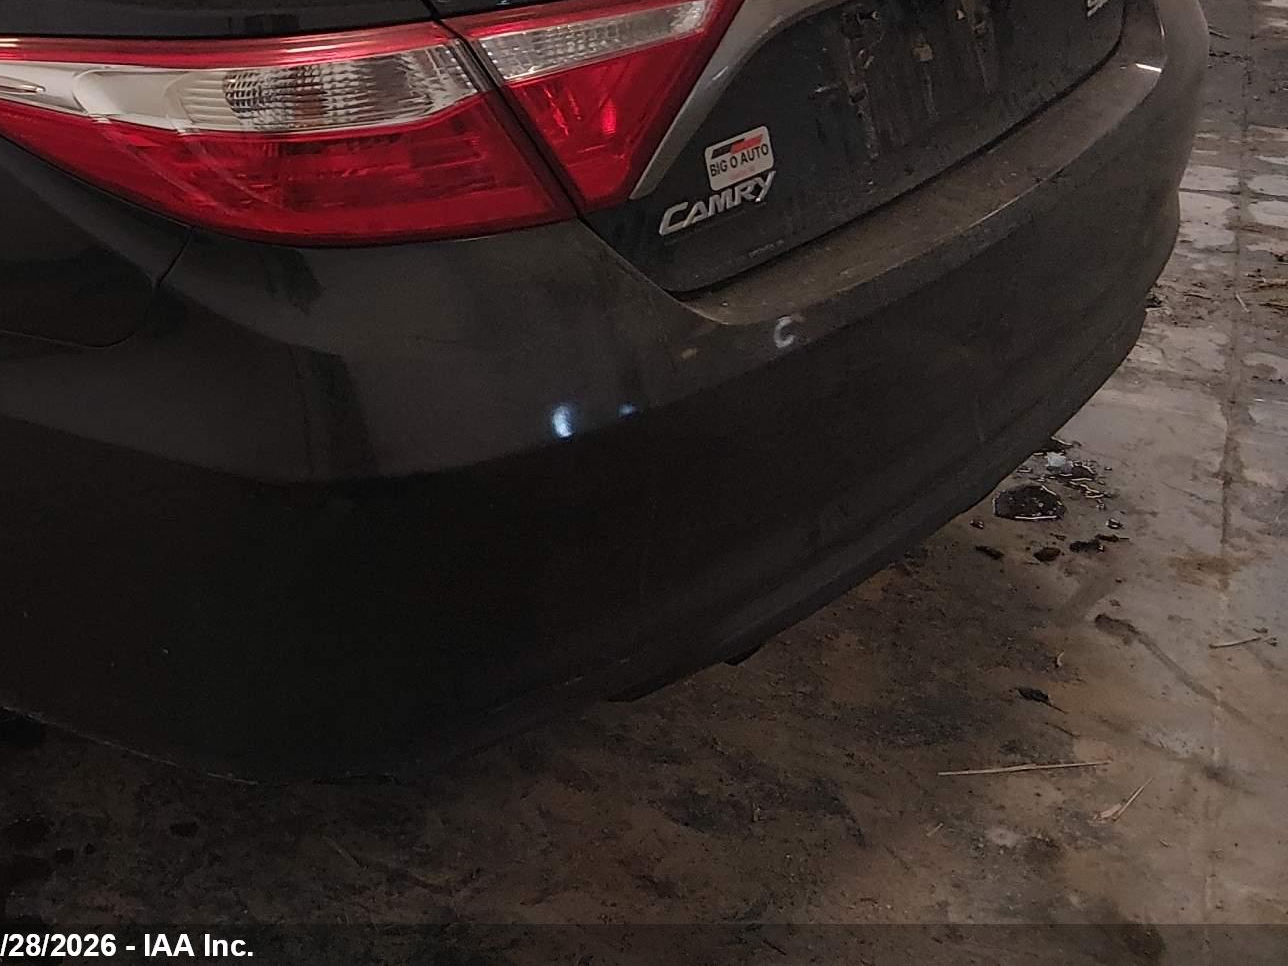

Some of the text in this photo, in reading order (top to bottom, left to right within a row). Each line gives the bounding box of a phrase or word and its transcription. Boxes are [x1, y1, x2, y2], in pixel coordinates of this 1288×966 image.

[709, 159, 729, 177] BIG
[729, 155, 739, 169] O
[740, 143, 770, 166] AUTO
[658, 170, 777, 236] CAMRY
